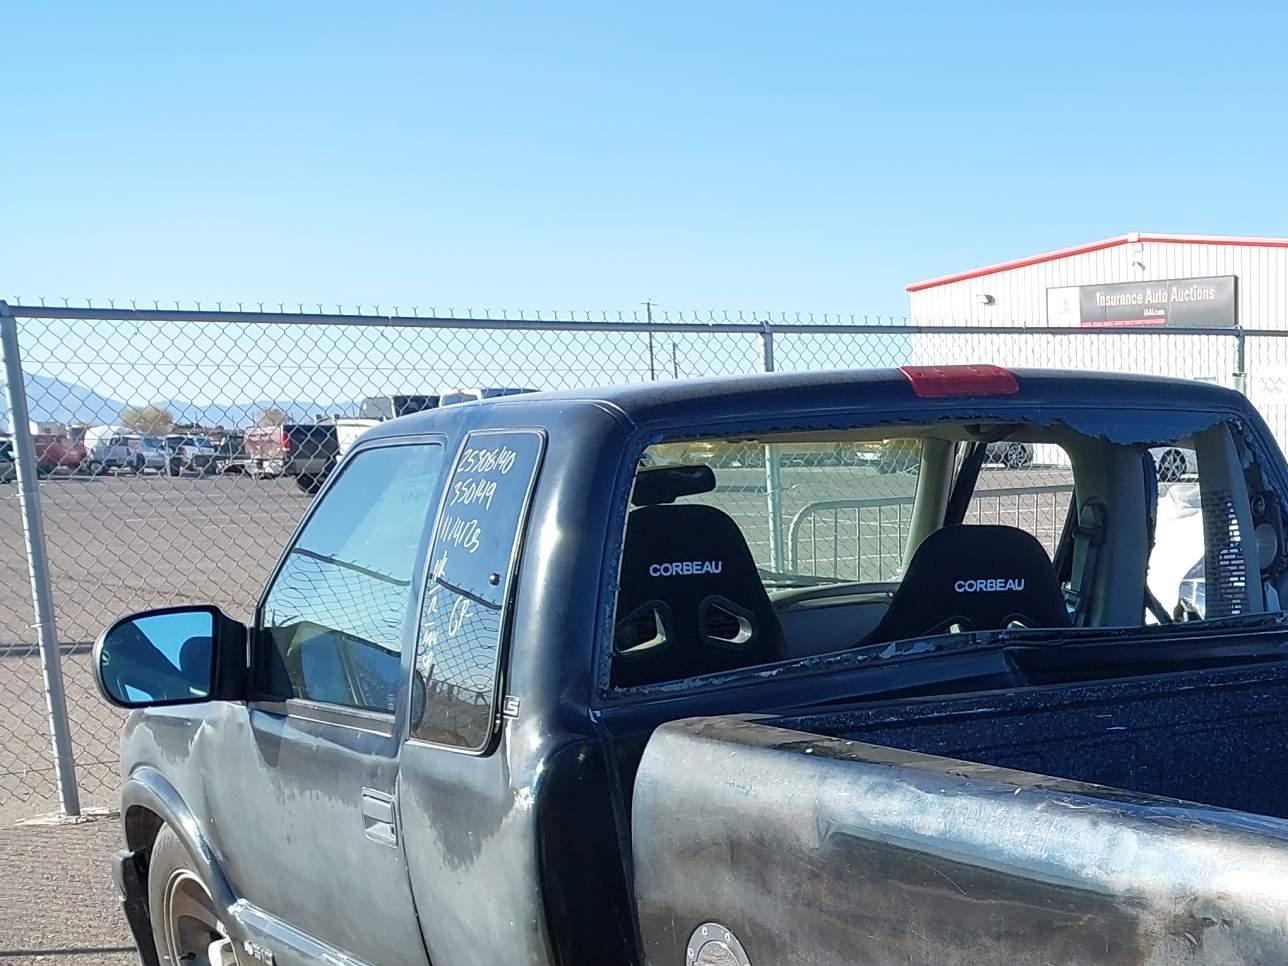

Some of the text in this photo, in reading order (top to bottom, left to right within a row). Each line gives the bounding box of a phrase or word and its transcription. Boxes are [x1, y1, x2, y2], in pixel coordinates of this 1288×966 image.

[1096, 284, 1215, 307] Insurance Auto Auctions
[649, 560, 722, 577] CORBEAU
[954, 577, 1025, 594] CORBEAU
